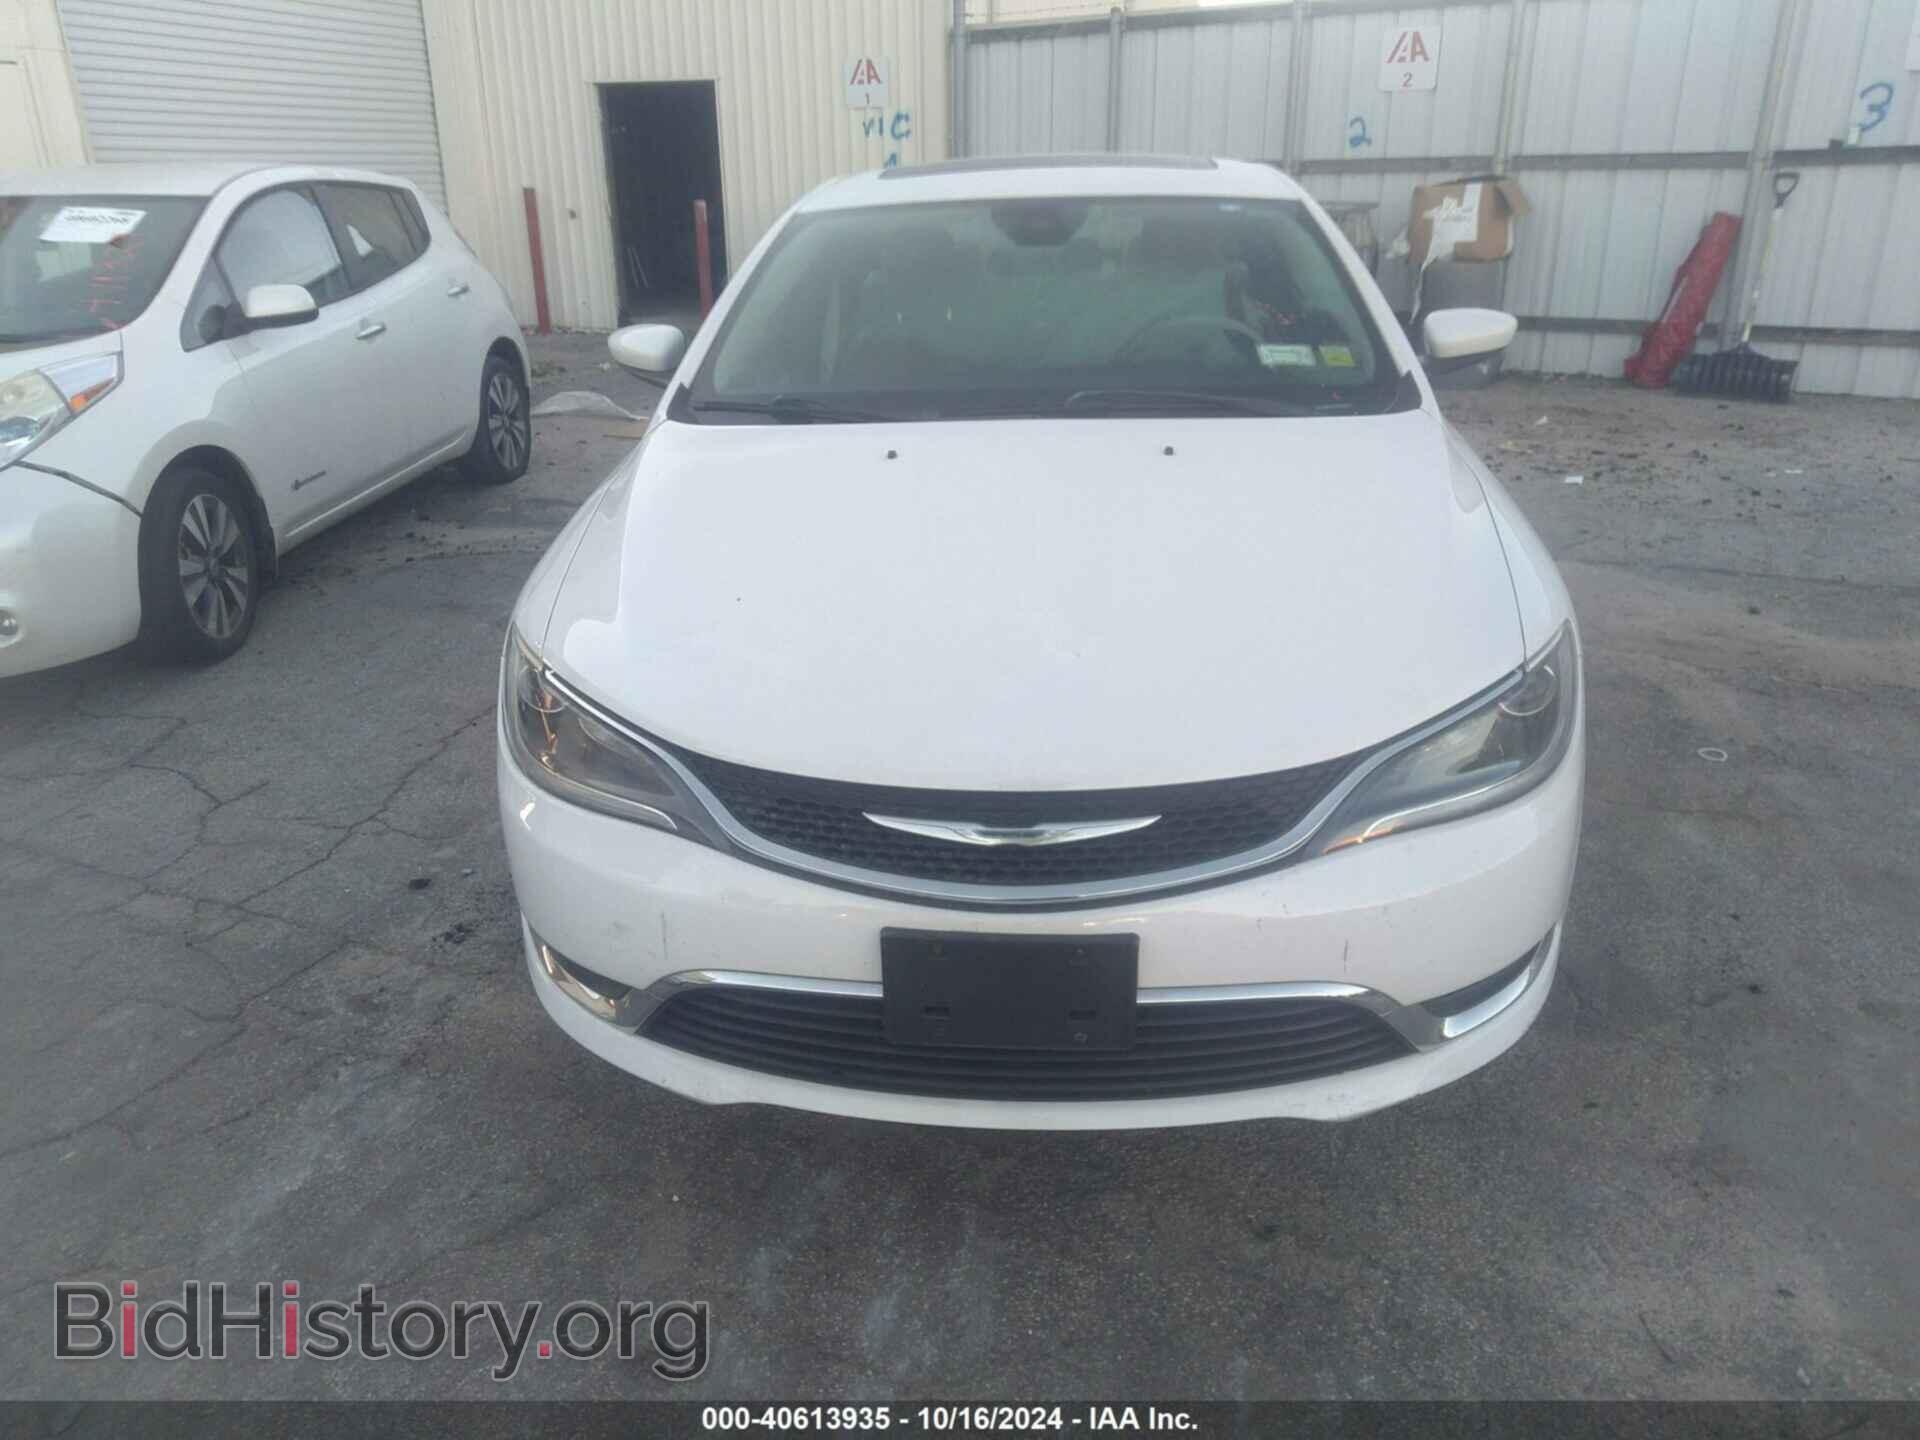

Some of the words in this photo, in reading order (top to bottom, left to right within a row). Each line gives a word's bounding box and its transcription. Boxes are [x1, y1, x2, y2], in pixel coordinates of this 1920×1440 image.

[1402, 72, 1413, 88] 2
[1858, 82, 1895, 133] 3
[1349, 116, 1373, 149] 2
